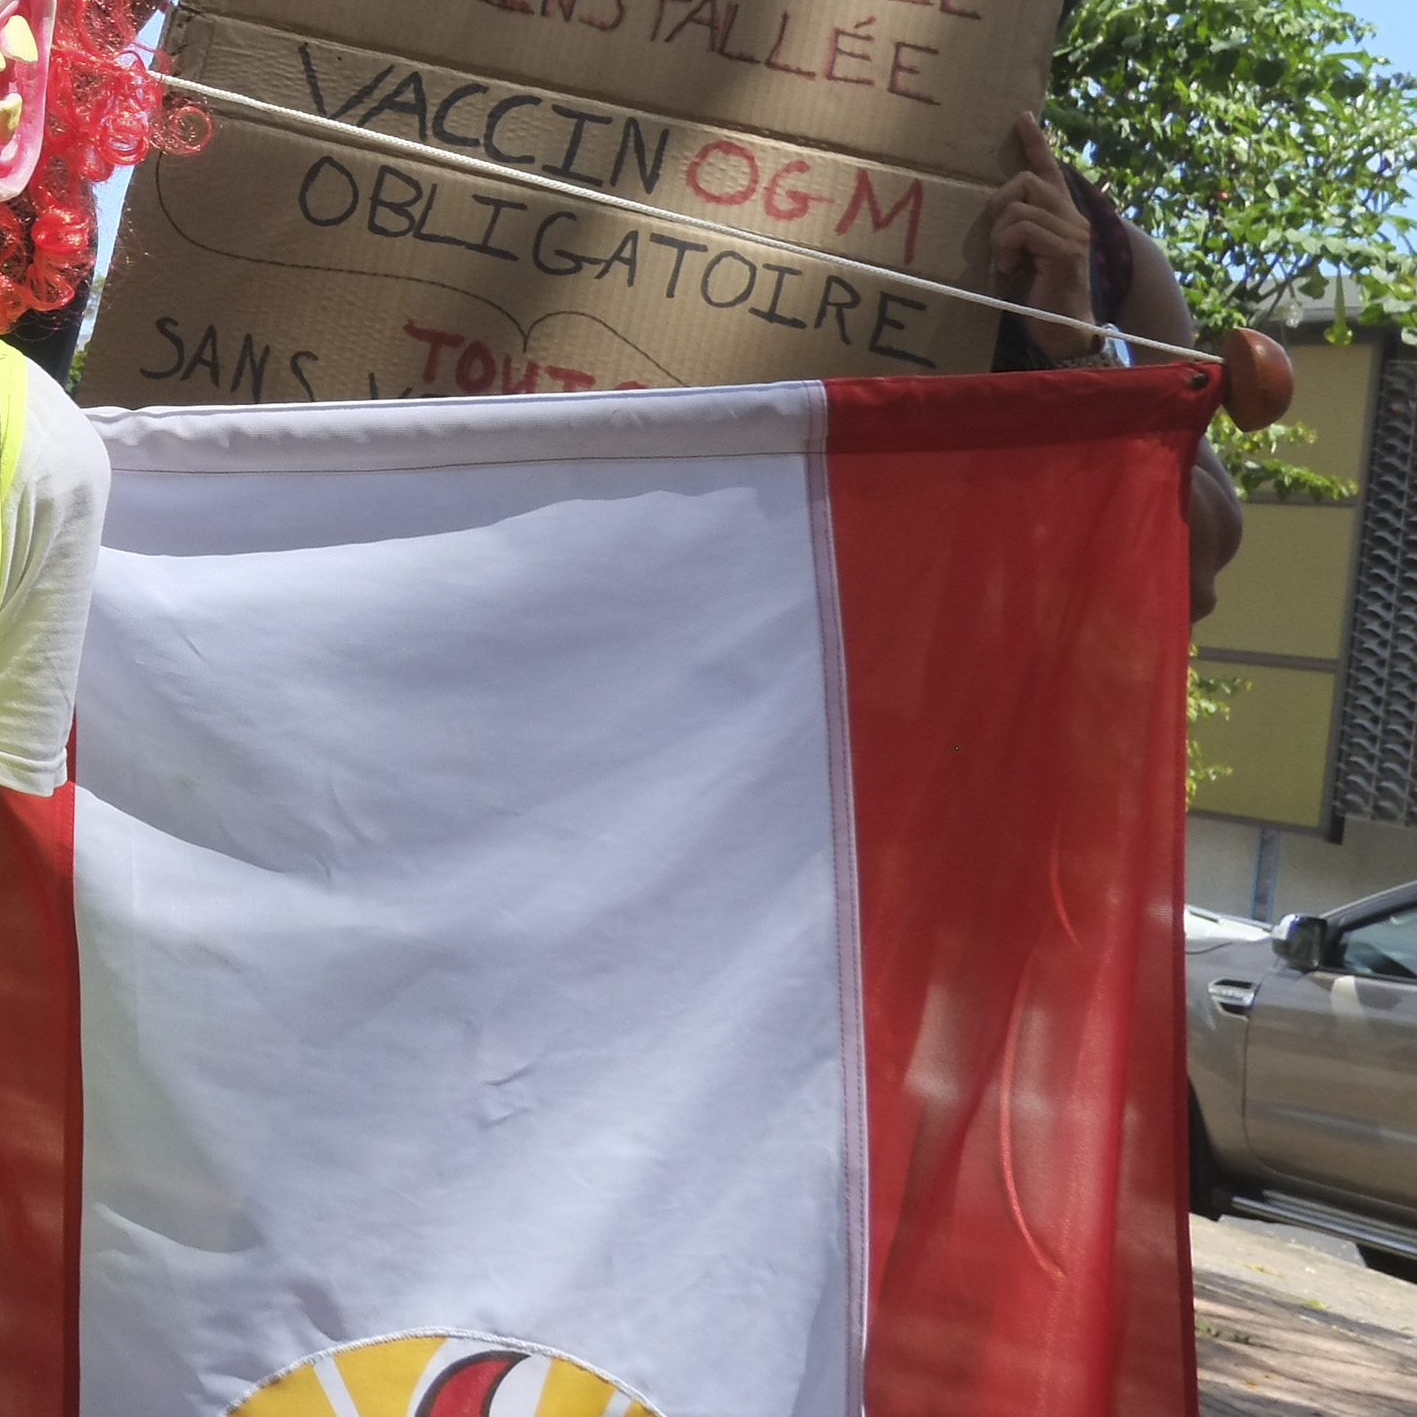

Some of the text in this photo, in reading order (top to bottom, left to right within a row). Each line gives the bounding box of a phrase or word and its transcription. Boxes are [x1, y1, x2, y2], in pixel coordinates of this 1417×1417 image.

[300, 44, 924, 263] VACCIN OGM
[298, 155, 937, 369] OBLIGATOIRE
